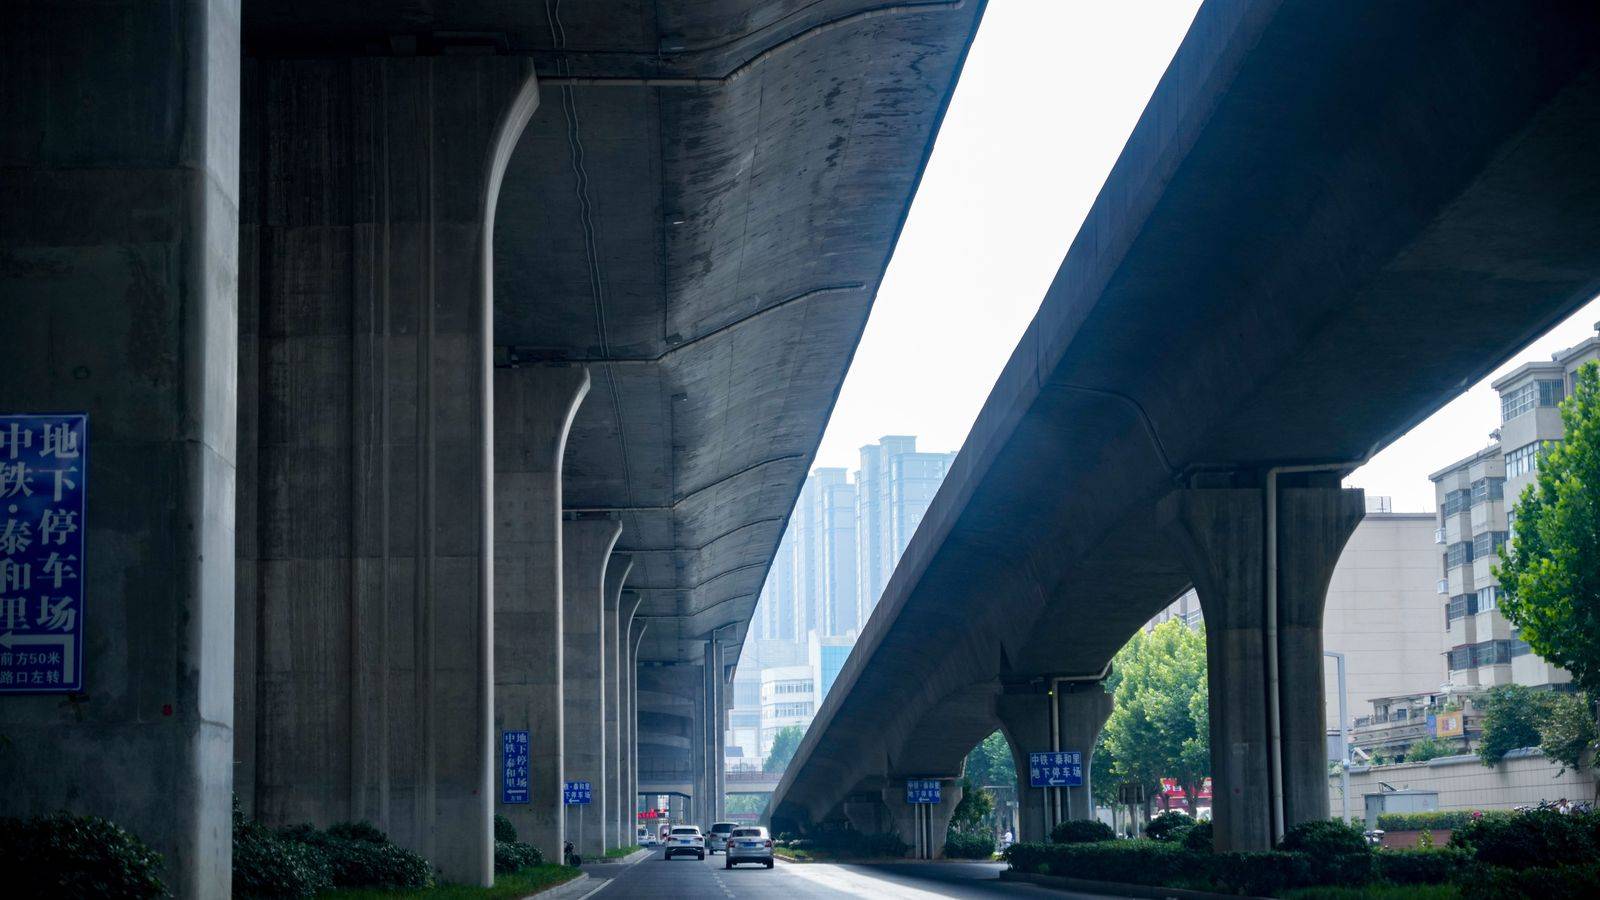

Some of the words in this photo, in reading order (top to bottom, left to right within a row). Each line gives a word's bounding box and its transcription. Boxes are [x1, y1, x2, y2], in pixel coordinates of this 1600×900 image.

[37, 423, 79, 632] 地下停车场
[1, 652, 60, 666] 前方50米
[0, 670, 60, 684] 路口左转
[1032, 754, 1079, 765] 中铁·泰和里
[1032, 767, 1080, 778] 地下停车场
